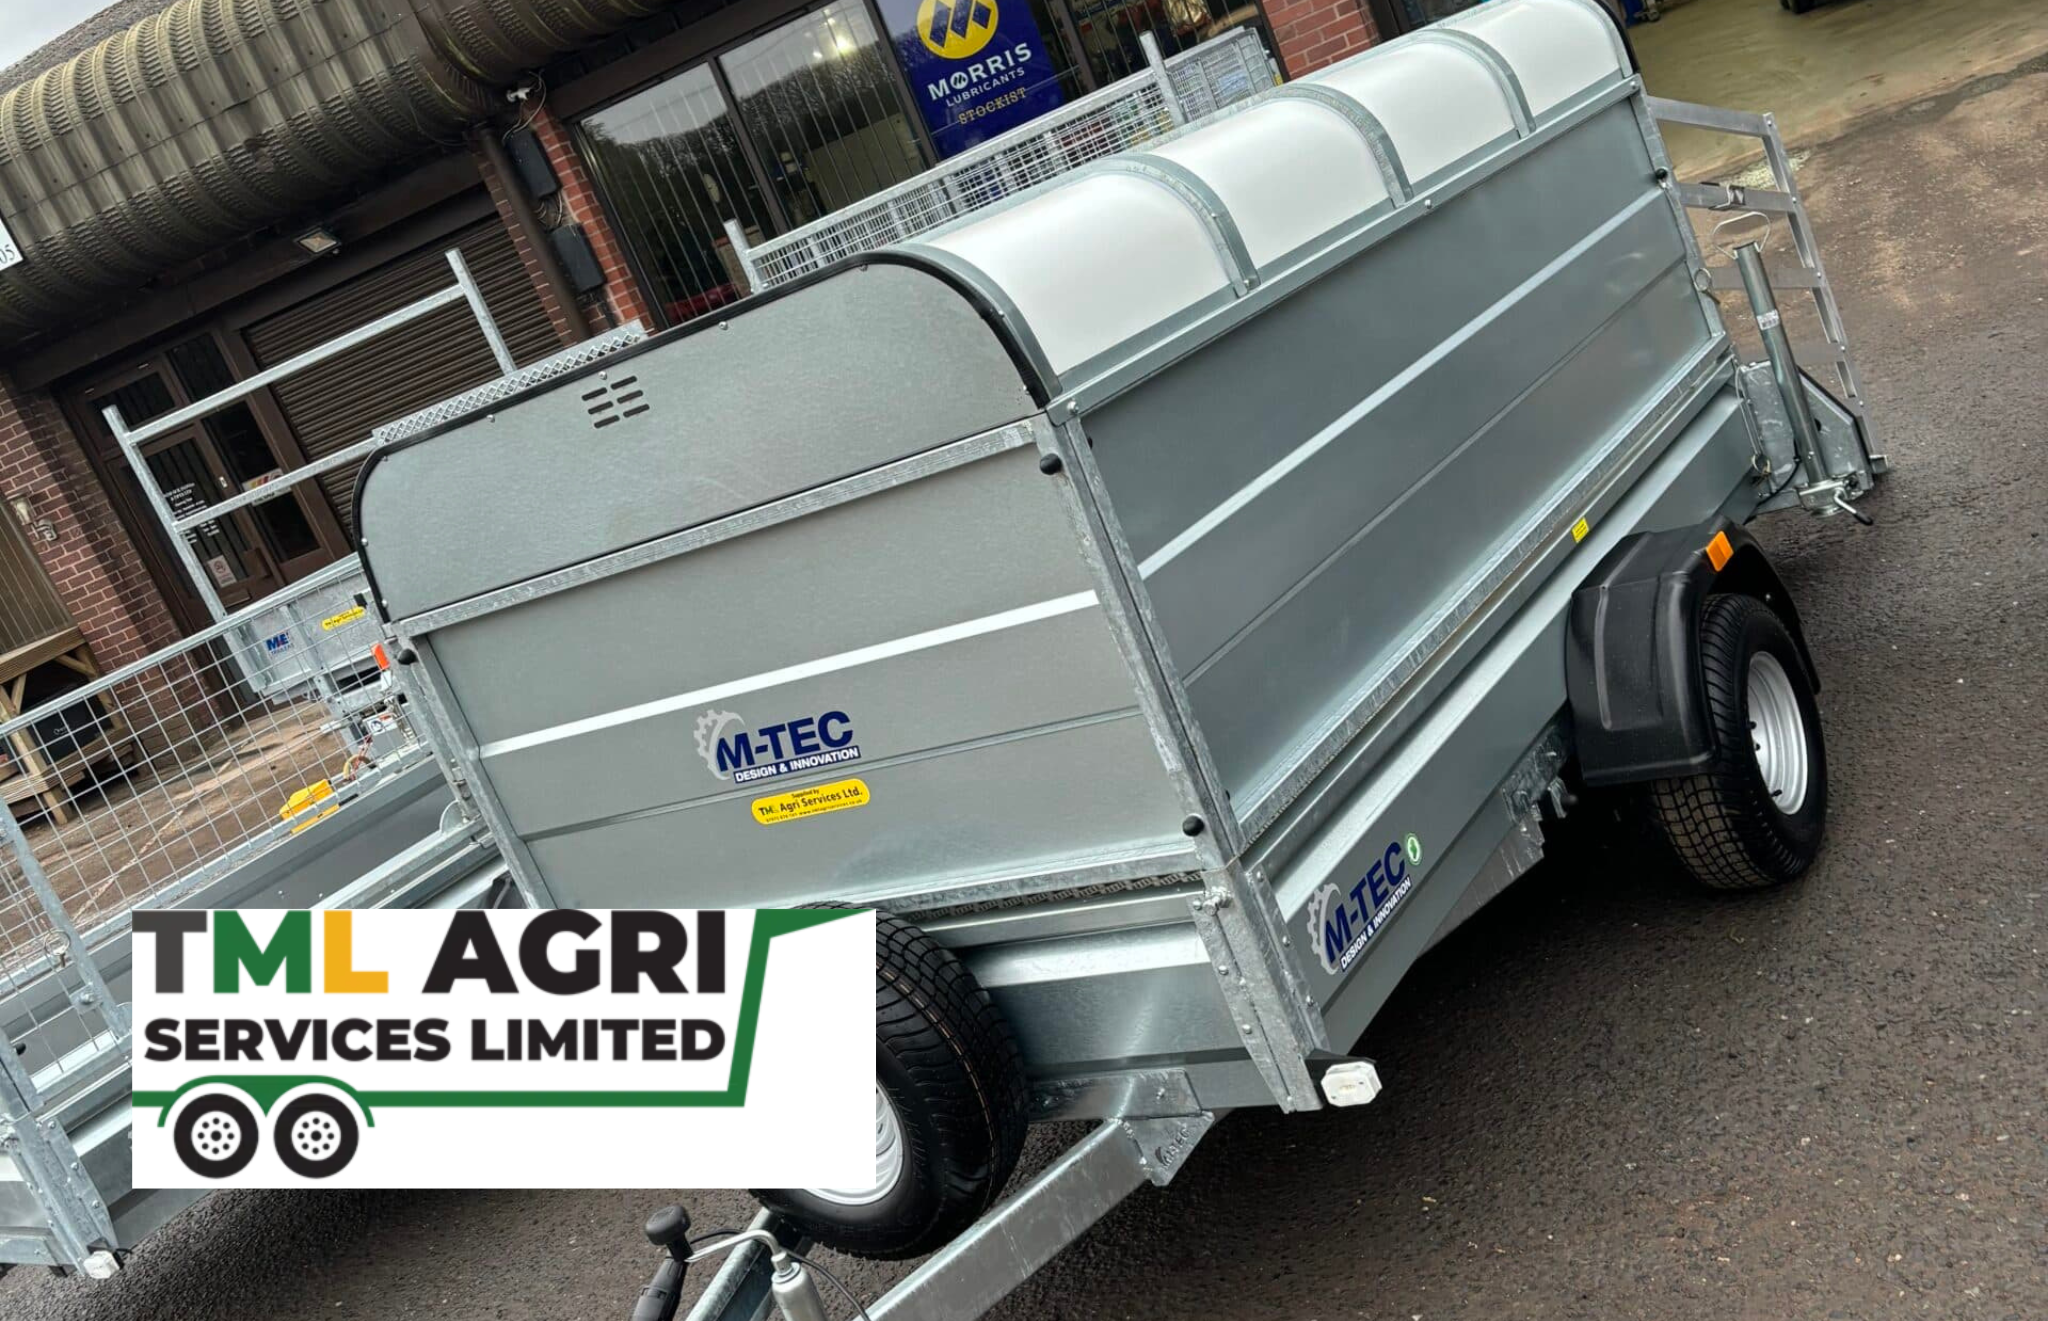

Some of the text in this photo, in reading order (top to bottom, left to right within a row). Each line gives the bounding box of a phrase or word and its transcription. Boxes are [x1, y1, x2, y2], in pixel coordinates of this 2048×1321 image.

[927, 42, 1032, 101] MORRIS
[945, 67, 1025, 107] LUBRICANTS
[958, 87, 1027, 125] STOCKIST
[716, 711, 853, 772] M-TEC
[735, 747, 859, 782] DESIGN & INNOVATION
[780, 799, 800, 813] Agri
[801, 792, 841, 807] Services
[842, 786, 863, 799] Ltd.
[1324, 842, 1405, 964] M-TEC
[1341, 877, 1411, 969] DESIGN & INNOVATION
